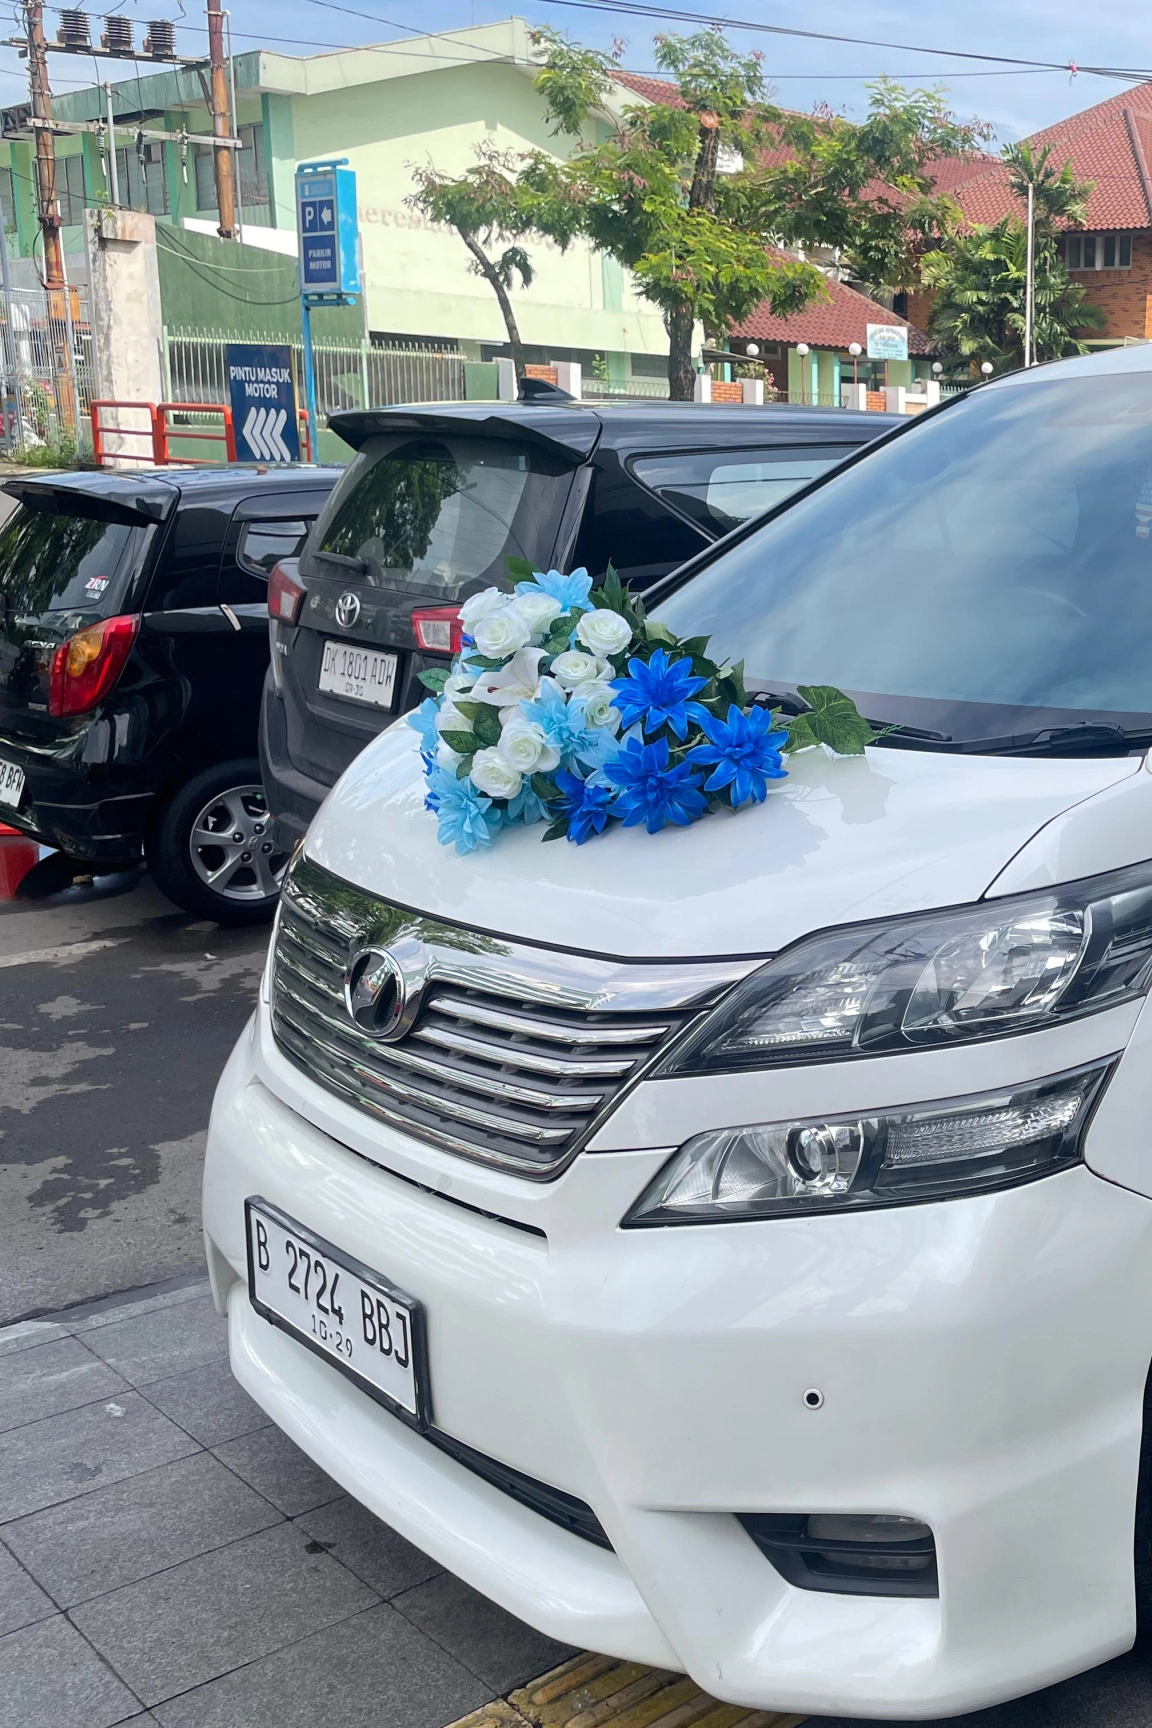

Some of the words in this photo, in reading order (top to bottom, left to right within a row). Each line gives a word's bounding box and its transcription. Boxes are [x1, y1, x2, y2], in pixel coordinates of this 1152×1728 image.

[305, 206, 315, 228] P
[308, 248, 332, 259] PARKIR
[309, 260, 332, 271] MOTOR
[229, 366, 256, 382] PINTU
[257, 367, 291, 383] MASUK
[245, 382, 278, 399] MOTOR
[323, 647, 338, 676] DK
[340, 650, 368, 681] 1801
[370, 657, 395, 688] ADW
[256, 1218, 270, 1272] B
[285, 1239, 344, 1326] 2724
[360, 1288, 409, 1369] BBJ
